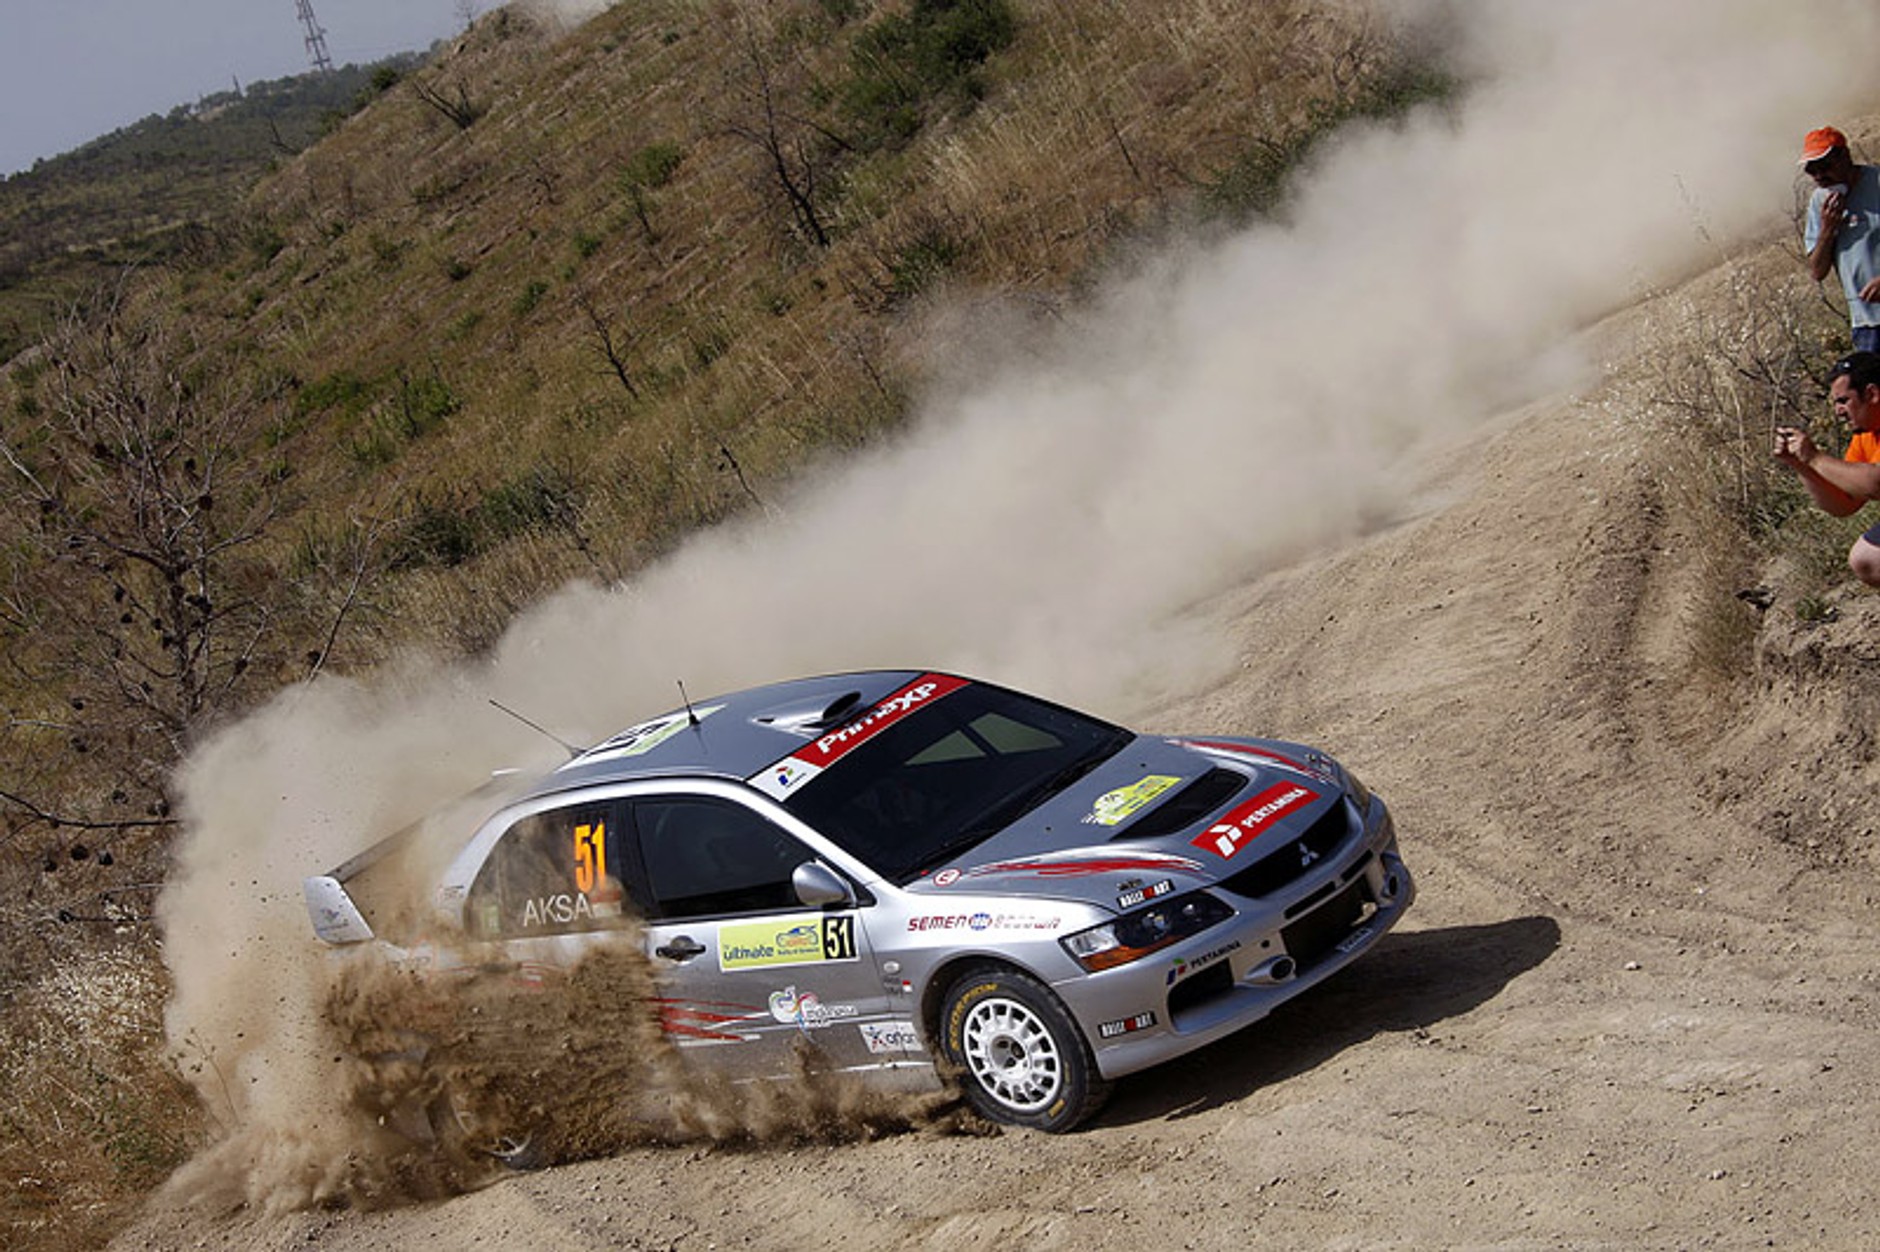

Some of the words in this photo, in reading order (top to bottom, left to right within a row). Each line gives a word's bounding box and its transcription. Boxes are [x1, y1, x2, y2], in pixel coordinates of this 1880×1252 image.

[815, 683, 938, 754] PrimaXP
[1240, 787, 1309, 829] PERTAMINA
[574, 821, 606, 894] 51
[523, 892, 594, 927] AKSA
[907, 915, 967, 931] SEMEN
[723, 943, 775, 961] ultimate
[826, 918, 851, 958] 51
[1189, 940, 1242, 969] PERTAMINA
